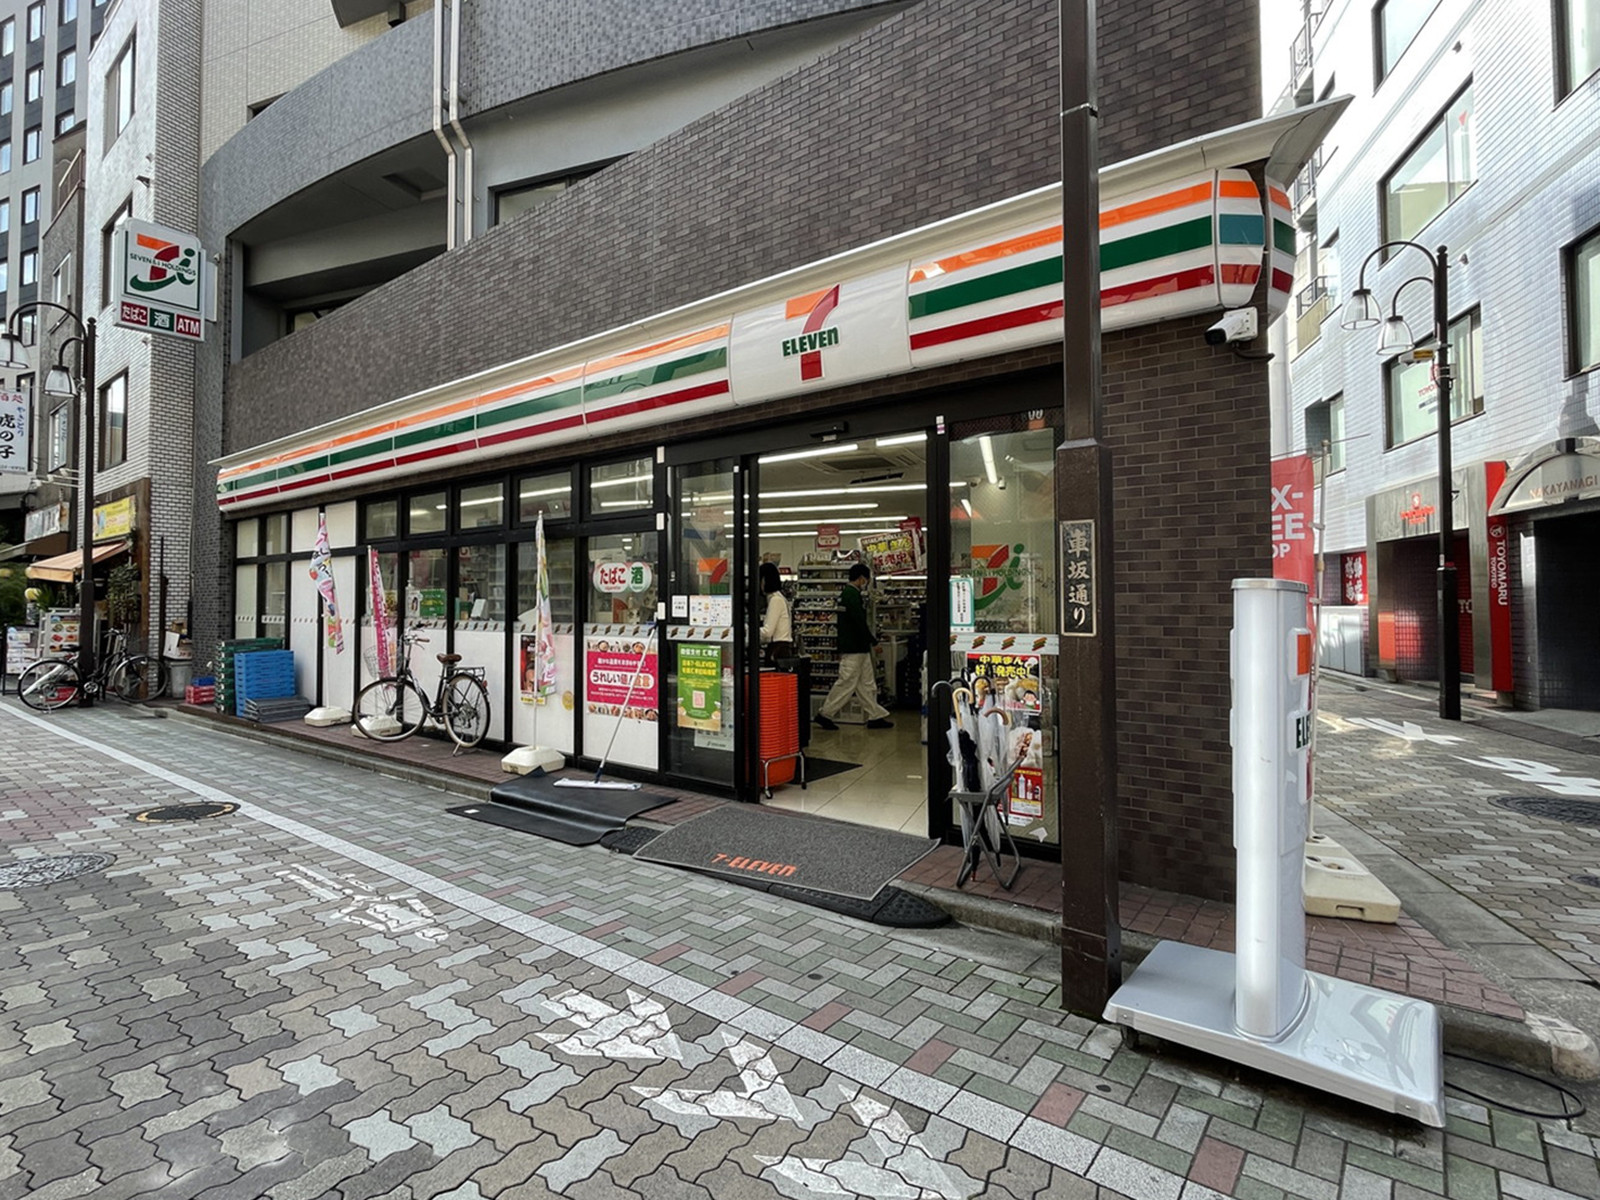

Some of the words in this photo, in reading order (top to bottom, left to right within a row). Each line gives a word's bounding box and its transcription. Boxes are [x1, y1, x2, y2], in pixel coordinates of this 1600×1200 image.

[121, 304, 147, 323] たばこ
[153, 311, 170, 328] 酒
[177, 317, 200, 335] ATM
[1528, 475, 1598, 499] NAKAYANAGI
[599, 566, 627, 585] たばこ
[631, 566, 644, 584] 酒
[1067, 528, 1092, 630] 車坂通り
[1496, 539, 1508, 606] TOYOMARU
